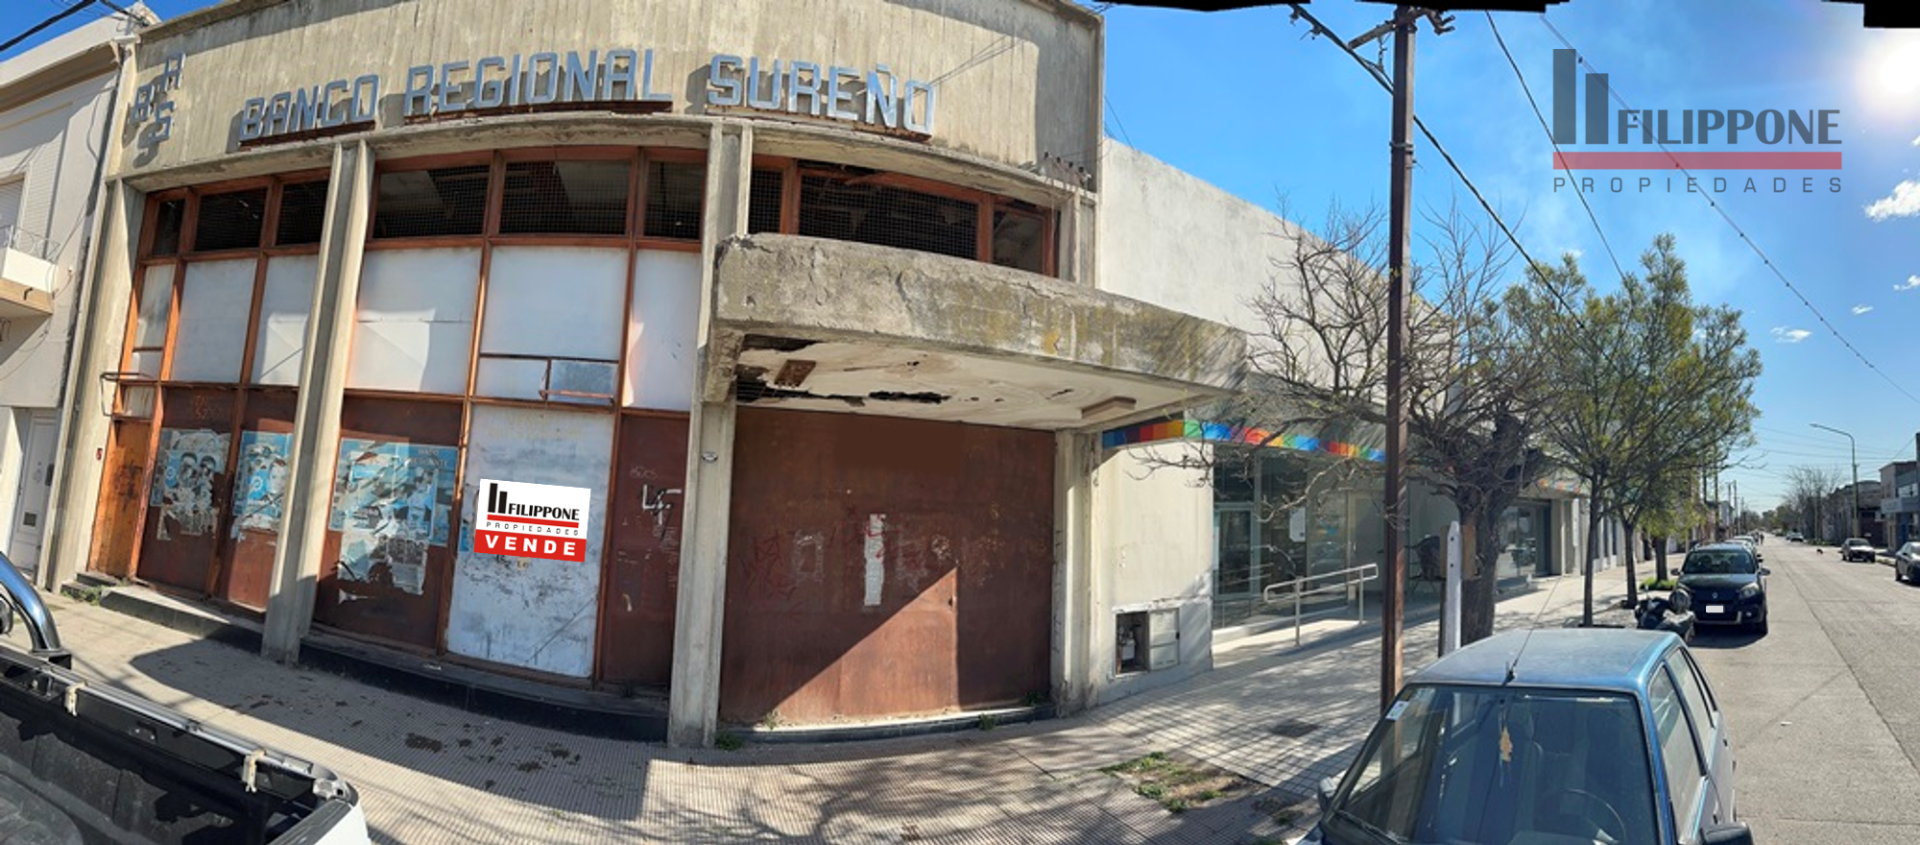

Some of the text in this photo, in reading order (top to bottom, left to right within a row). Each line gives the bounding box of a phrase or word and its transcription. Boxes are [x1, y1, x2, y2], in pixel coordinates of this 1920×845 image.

[240, 48, 936, 142] BANCO REGIONAL SUREÑO
